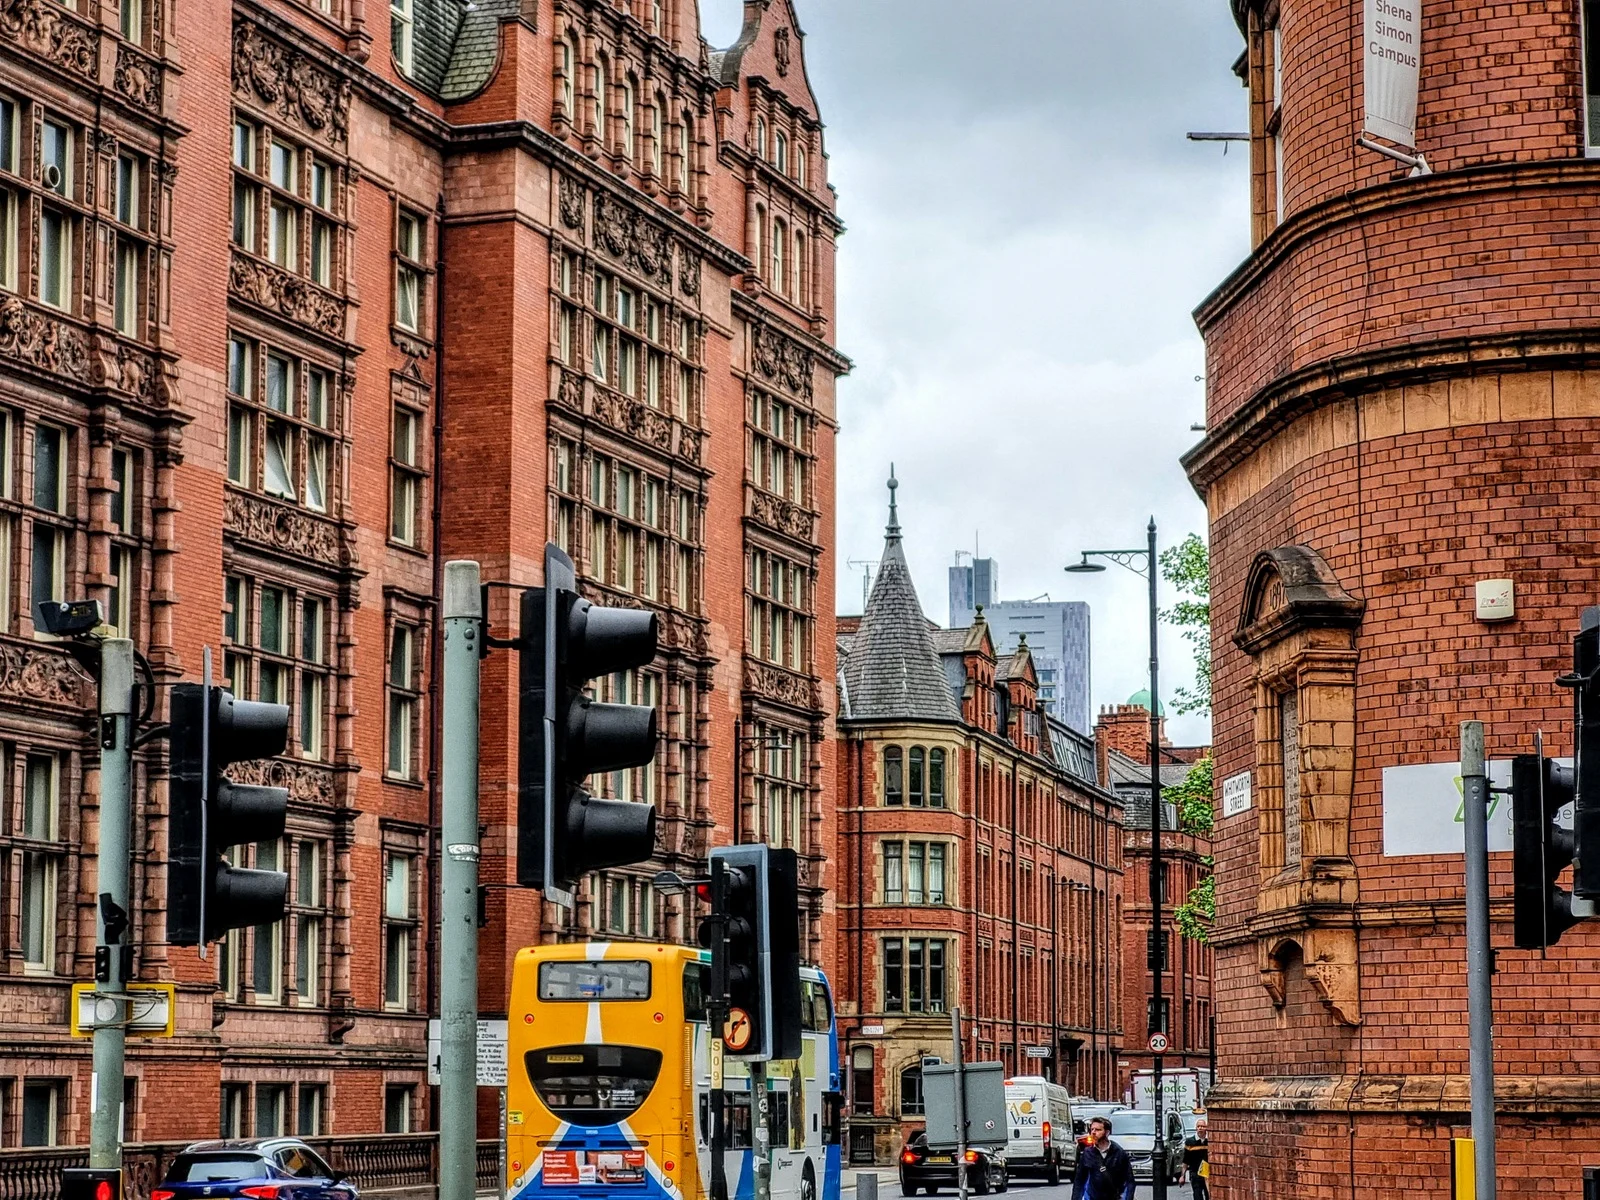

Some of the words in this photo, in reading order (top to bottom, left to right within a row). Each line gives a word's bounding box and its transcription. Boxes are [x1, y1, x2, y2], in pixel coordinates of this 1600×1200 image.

[1376, 0, 1412, 22] Shena
[1375, 21, 1412, 44] Simon
[1369, 41, 1417, 68] Campus
[1224, 775, 1250, 796] WHITWORTH
[1230, 793, 1245, 812] STREET
[1151, 1038, 1166, 1048] 20
[1010, 1111, 1037, 1125] VEG
